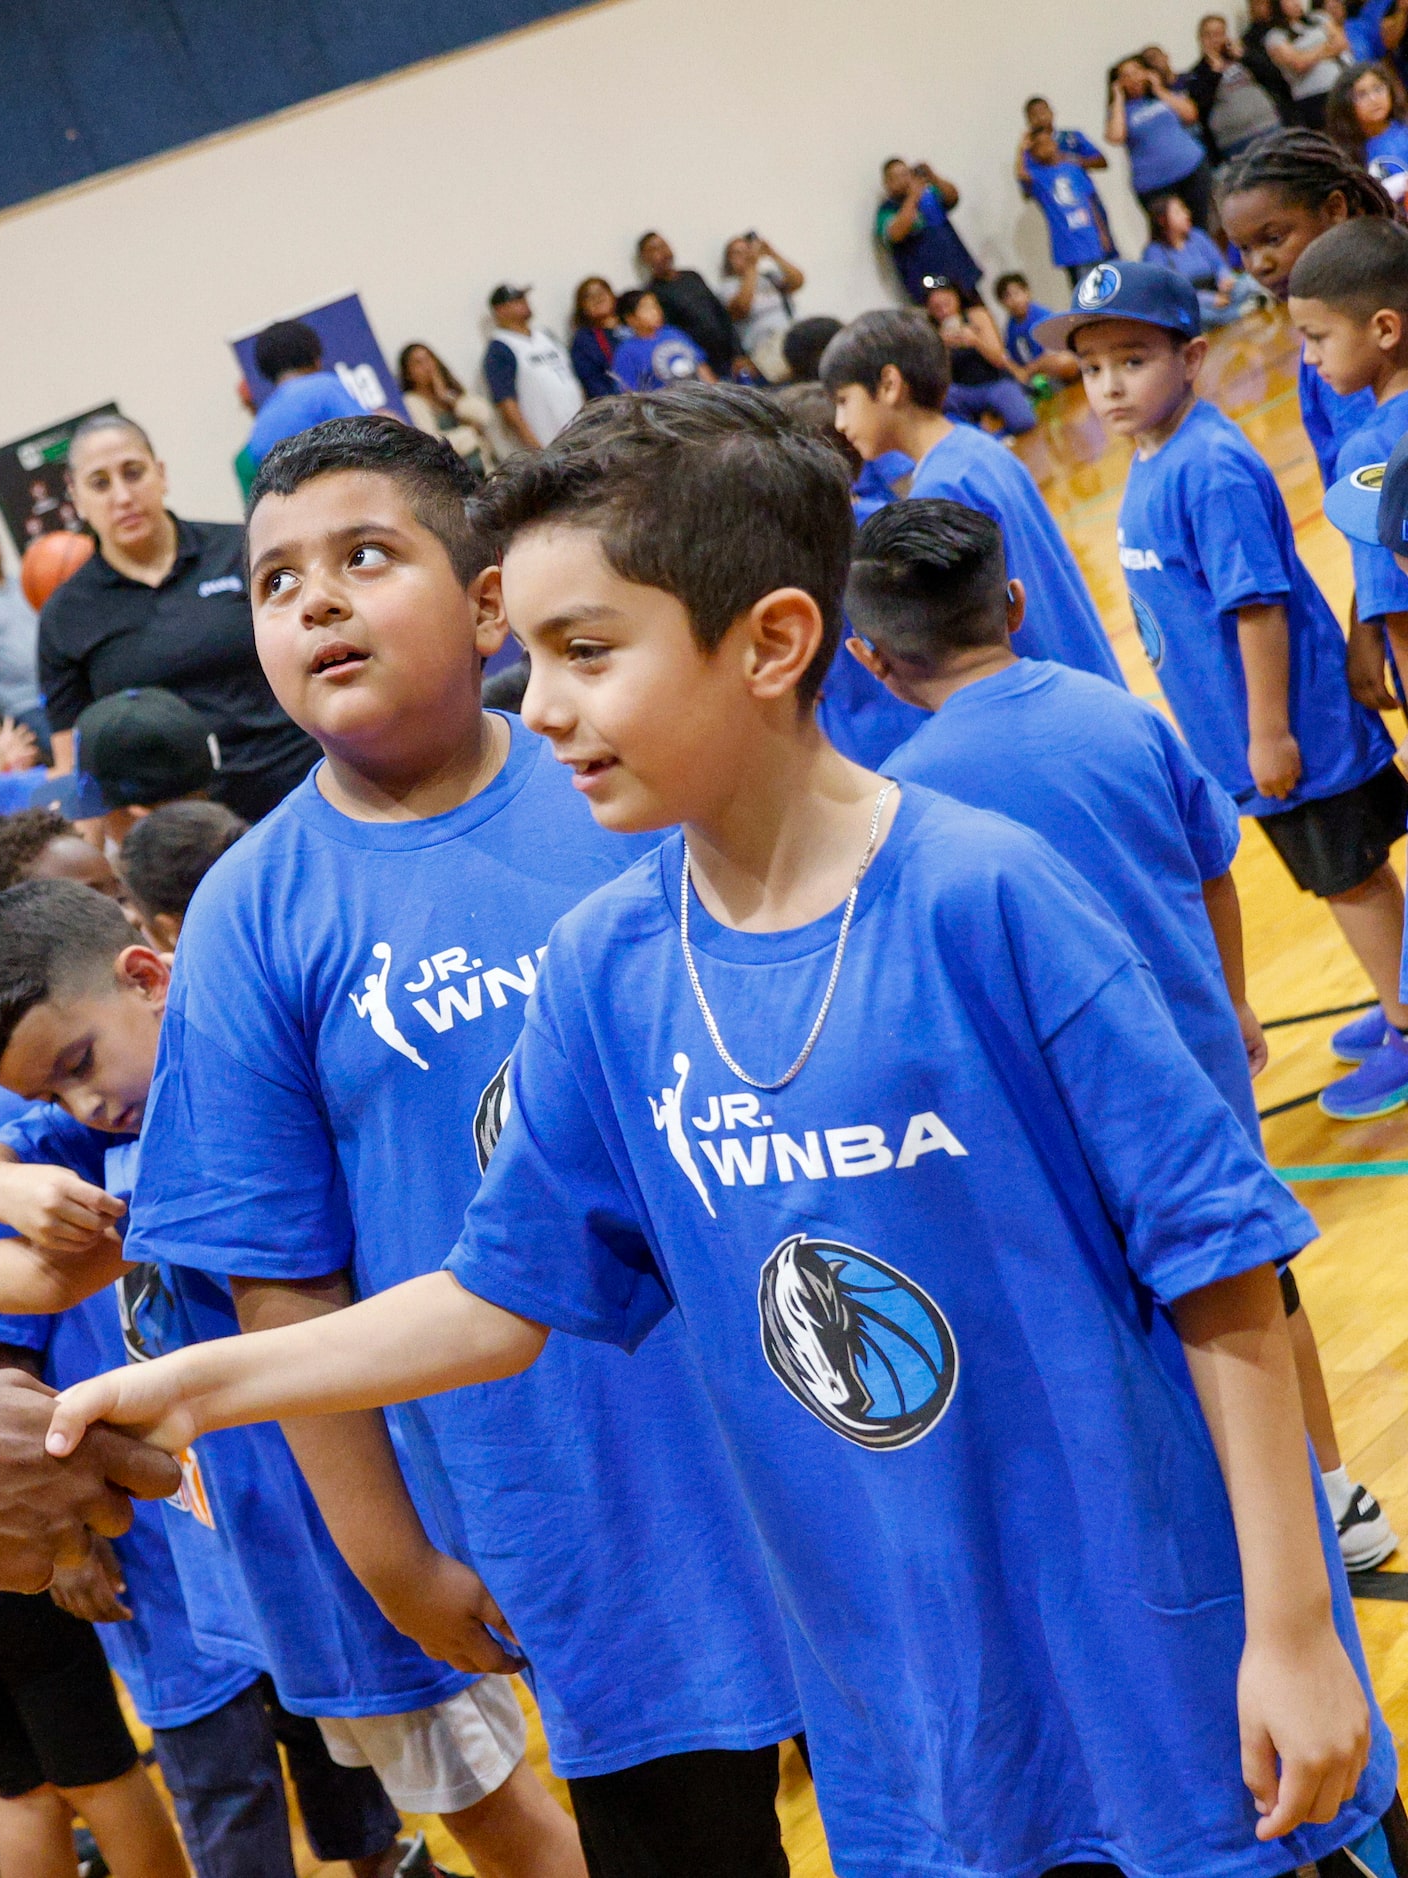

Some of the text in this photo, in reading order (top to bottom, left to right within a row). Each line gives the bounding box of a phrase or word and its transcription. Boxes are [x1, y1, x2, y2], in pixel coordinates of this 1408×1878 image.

[404, 946, 484, 993] JR.
[411, 944, 549, 1034] WN
[691, 1092, 774, 1133] JR.
[697, 1110, 969, 1187] WNBA
